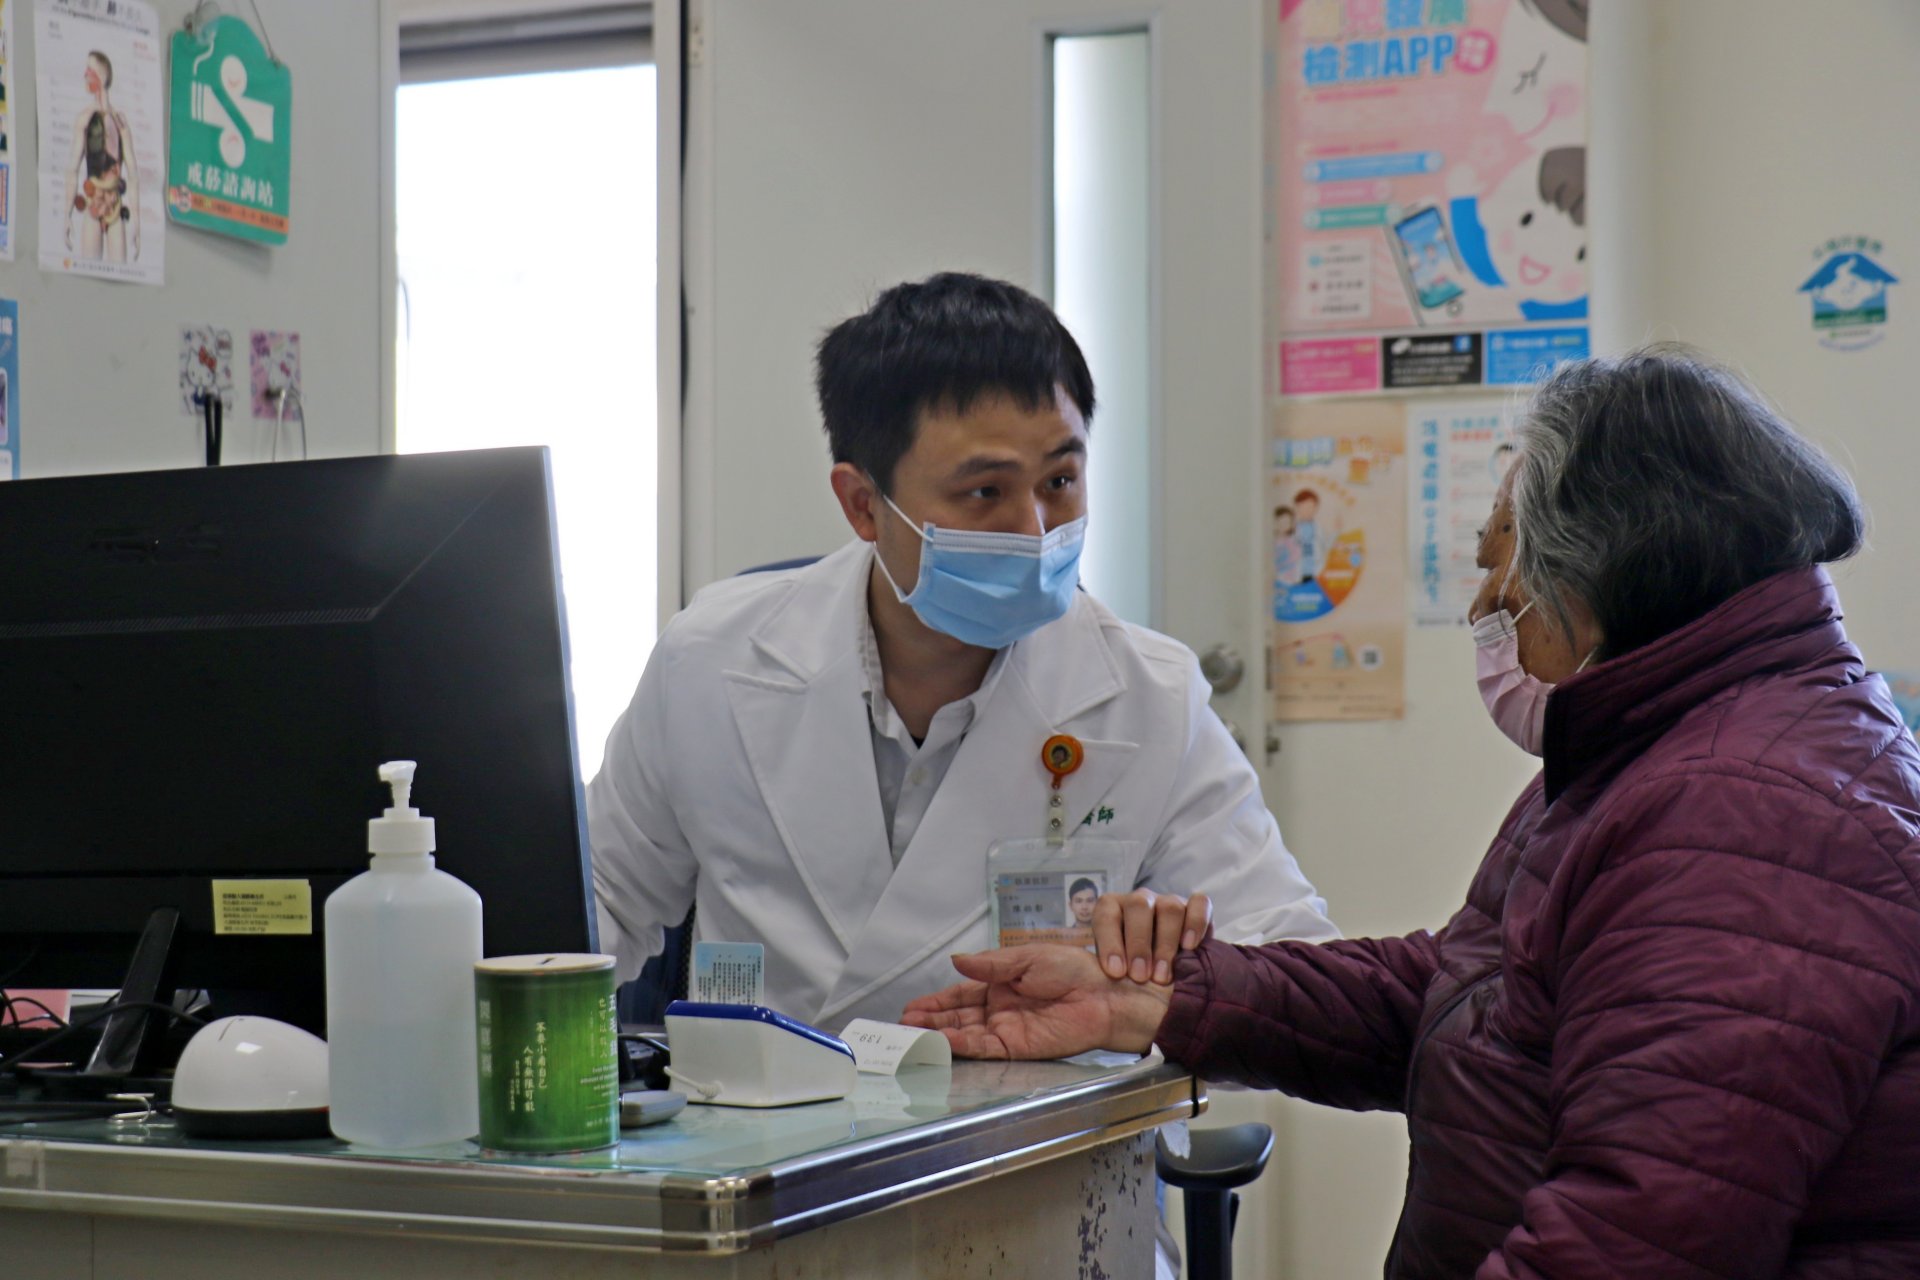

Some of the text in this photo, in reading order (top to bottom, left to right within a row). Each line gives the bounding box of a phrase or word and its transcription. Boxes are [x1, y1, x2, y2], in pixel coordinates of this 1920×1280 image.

[1303, 33, 1454, 87] 檢測APP
[187, 161, 273, 208] 戒菸諮詢站
[523, 1045, 535, 1112] 人有無限可能
